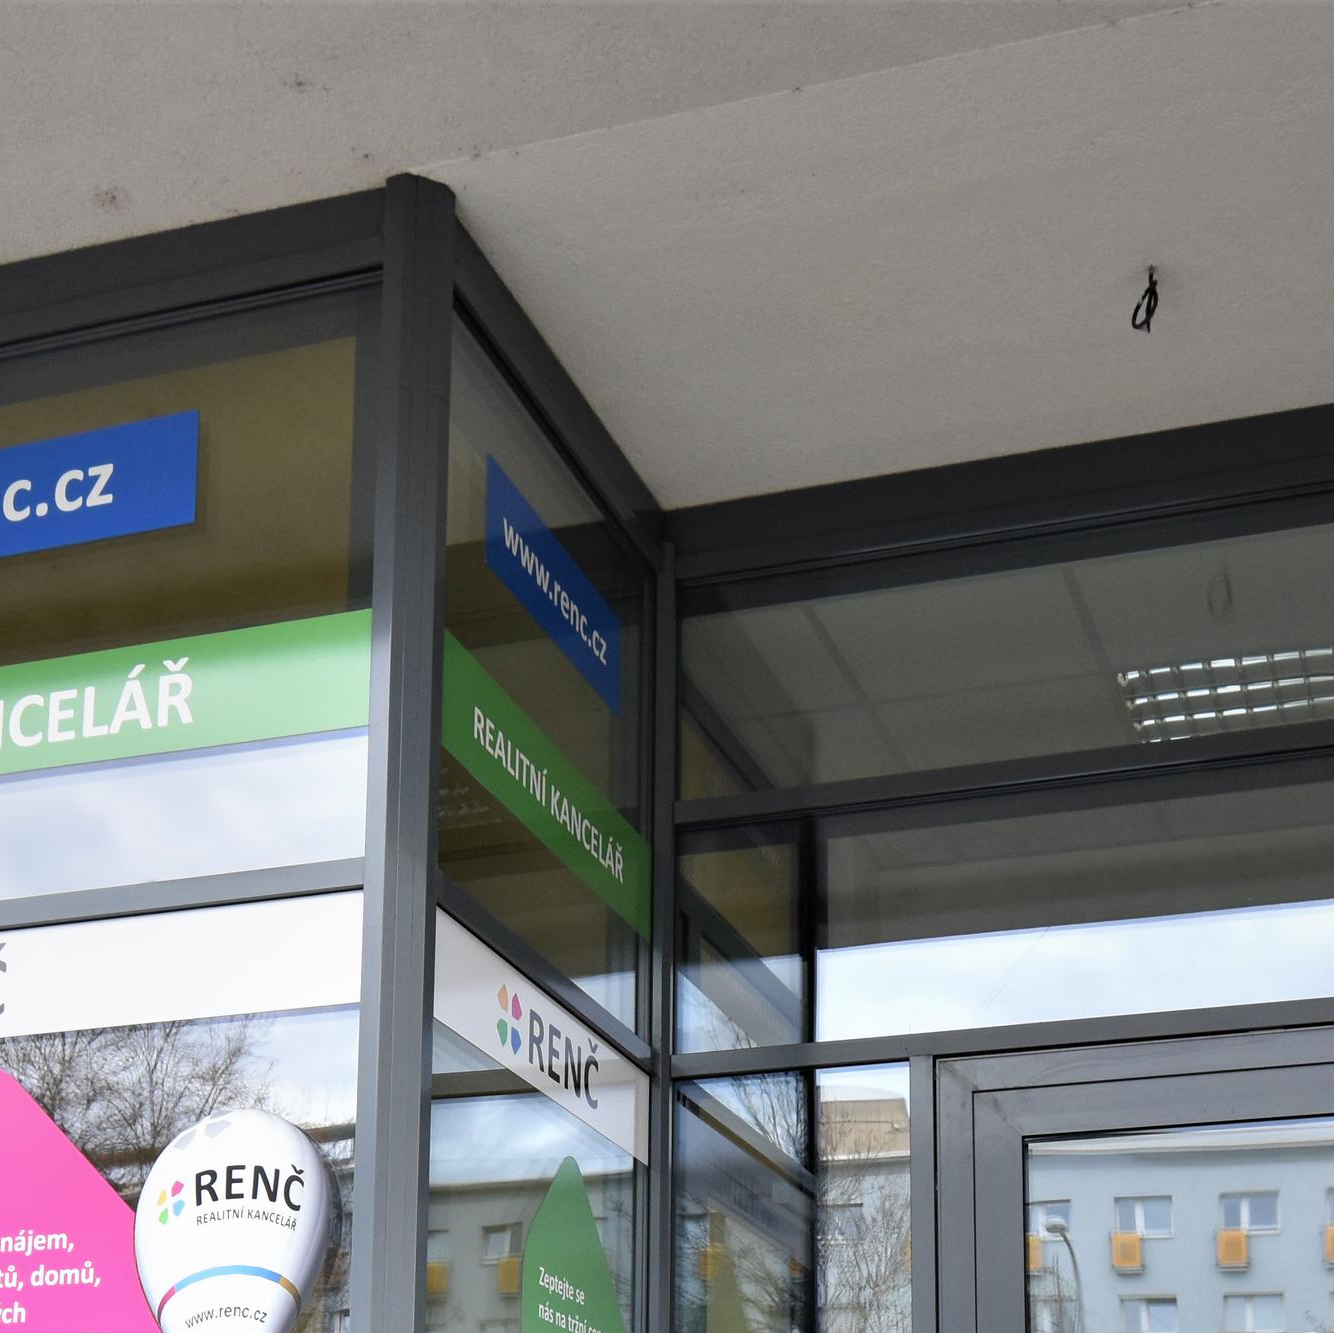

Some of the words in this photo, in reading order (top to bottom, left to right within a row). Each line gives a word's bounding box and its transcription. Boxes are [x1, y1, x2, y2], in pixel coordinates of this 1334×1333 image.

[502, 517, 608, 667] www.renc.cz
[473, 705, 547, 807] REALITNÍ
[550, 789, 625, 884] KANCELÁŘ
[527, 1007, 601, 1110] RENČ
[195, 1164, 305, 1212] RENČ
[196, 1206, 245, 1226] REALITNÍ
[247, 1206, 298, 1231] KANCELÁŘ
[30, 1260, 101, 1288] domů,
[539, 1266, 574, 1301] Zeptejte
[576, 1289, 585, 1305] se
[185, 1305, 268, 1329] www.renc.cz
[539, 1301, 554, 1323] nás
[555, 1312, 566, 1329] na
